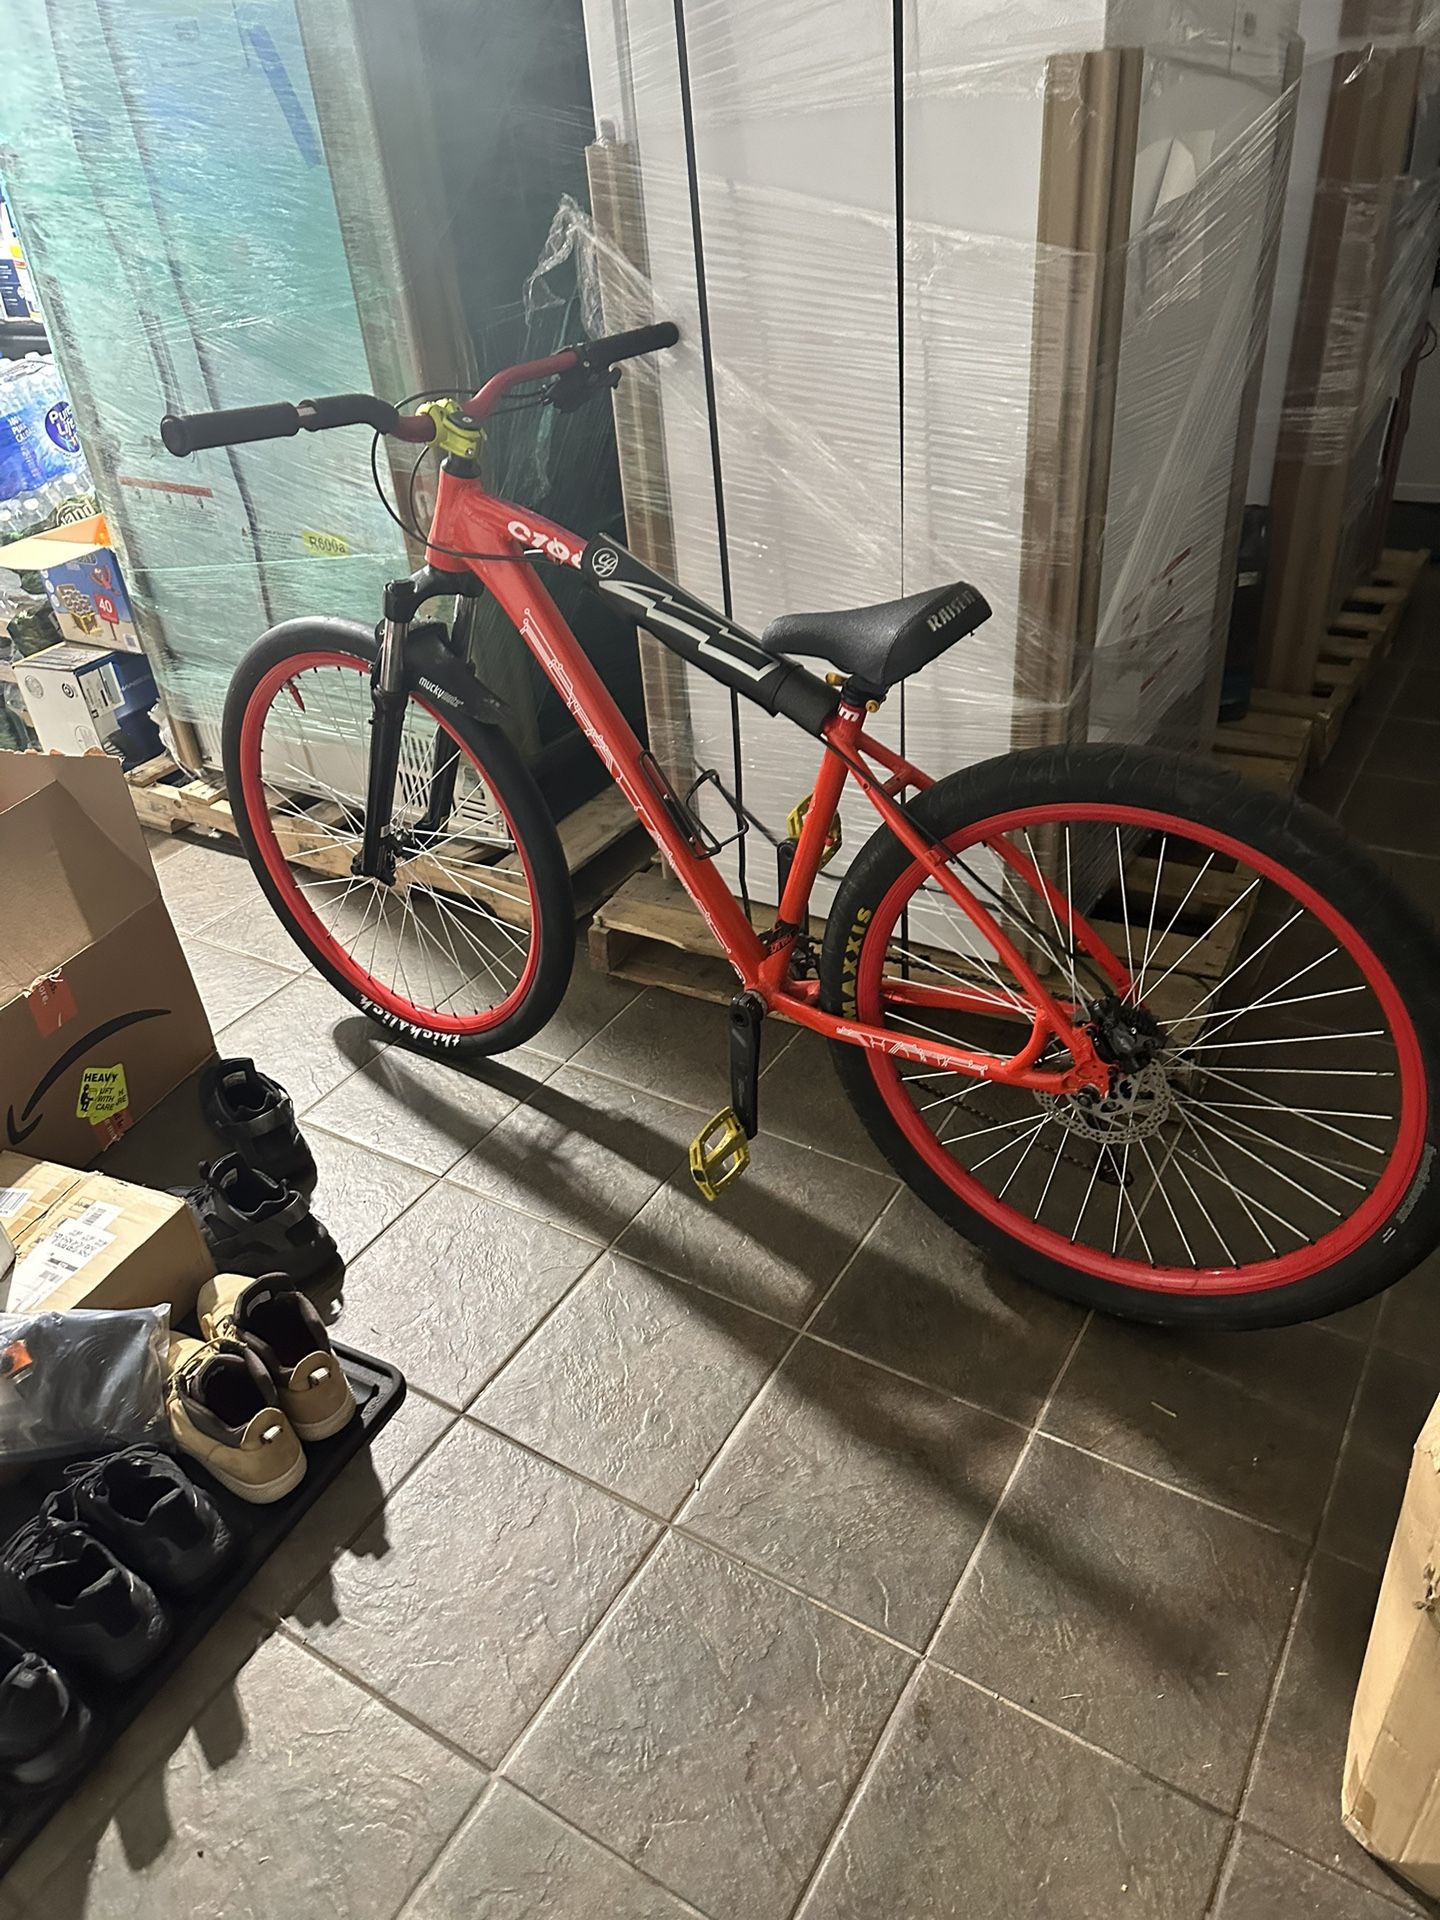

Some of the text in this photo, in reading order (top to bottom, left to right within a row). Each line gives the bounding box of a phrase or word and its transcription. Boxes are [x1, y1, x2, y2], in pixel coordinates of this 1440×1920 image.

[309, 535, 346, 553] R600a
[99, 598, 113, 613] 40
[841, 907, 872, 1020] MAXXIS
[360, 993, 461, 1048] thickslick
[84, 1073, 118, 1083] HEAVY
[100, 1087, 115, 1095] LIFT
[95, 1103, 115, 1111] CARE
